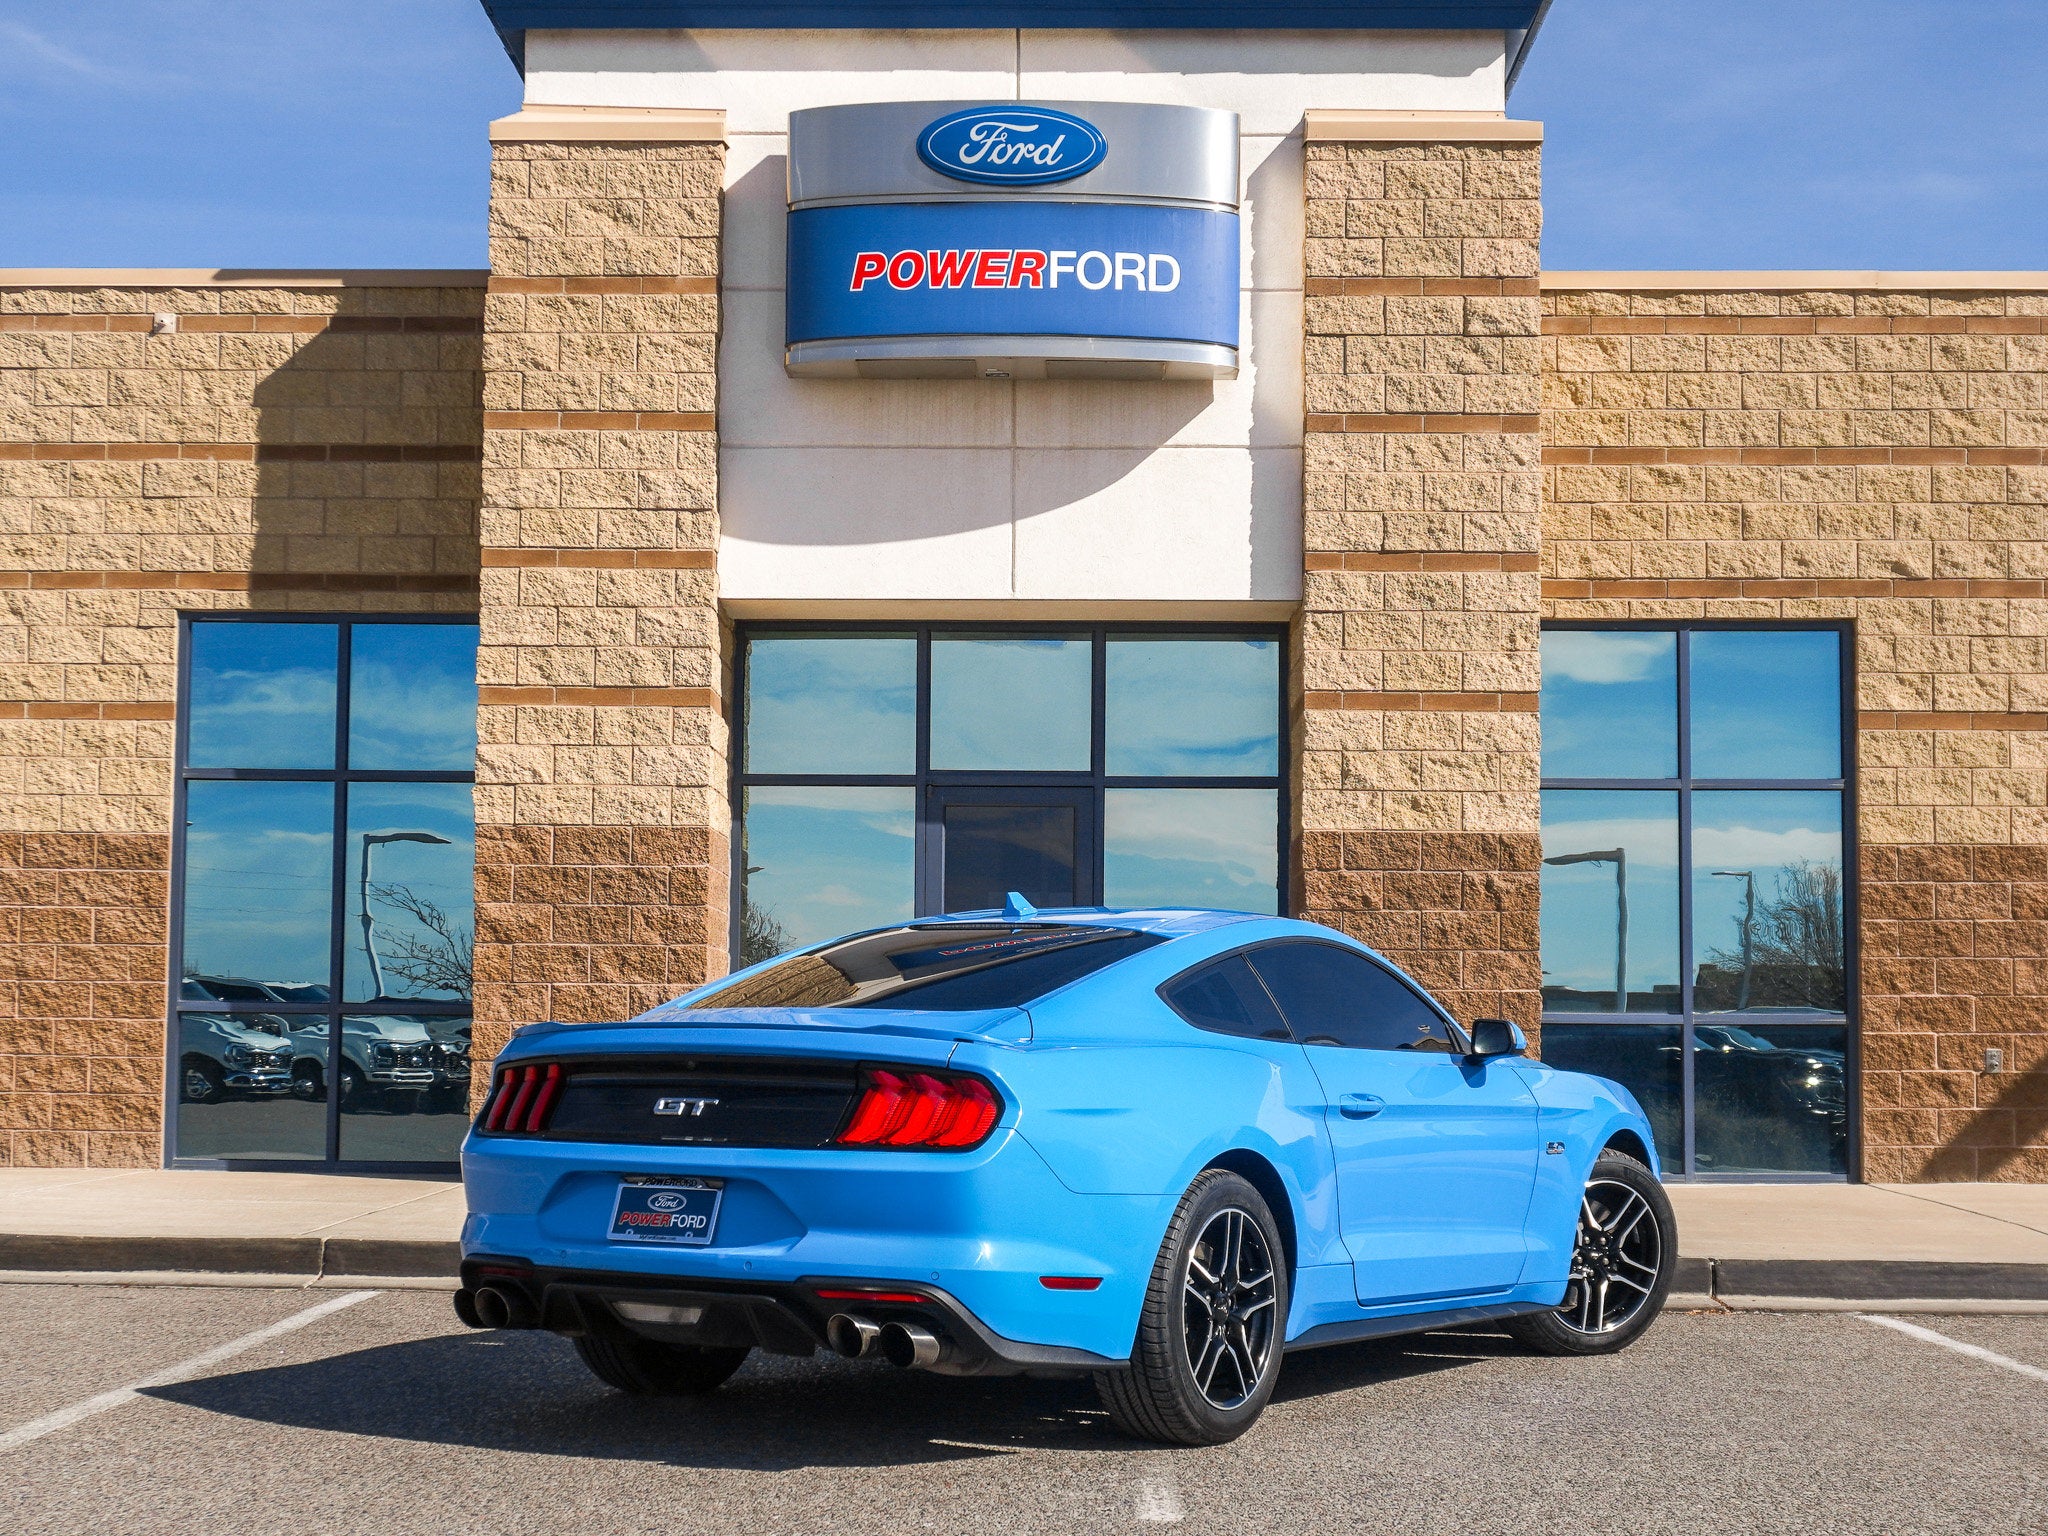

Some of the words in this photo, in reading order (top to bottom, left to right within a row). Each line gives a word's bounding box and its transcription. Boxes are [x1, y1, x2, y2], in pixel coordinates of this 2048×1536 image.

[958, 121, 1066, 165] Ford
[849, 249, 1181, 293] POWERFORD
[653, 1097, 720, 1116] GT
[654, 1195, 680, 1208] Ford
[618, 1211, 707, 1229] POWERFORD
